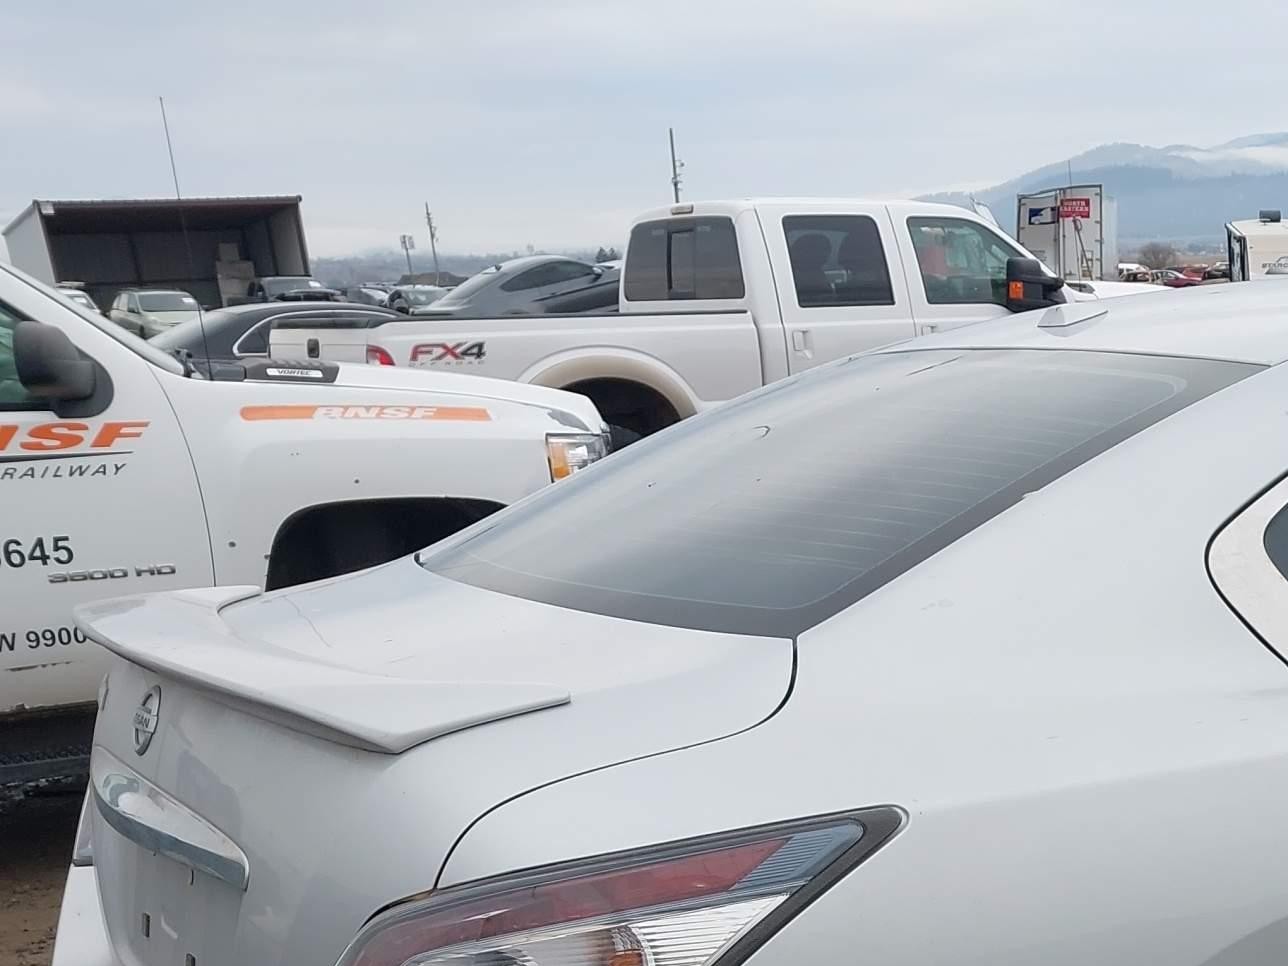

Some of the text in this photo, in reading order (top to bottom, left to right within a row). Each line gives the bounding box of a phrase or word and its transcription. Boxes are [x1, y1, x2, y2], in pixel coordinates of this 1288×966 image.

[409, 341, 487, 362] FX4
[312, 405, 439, 420] BNSF
[0, 463, 126, 480] RAILWAY
[134, 564, 177, 577] HD
